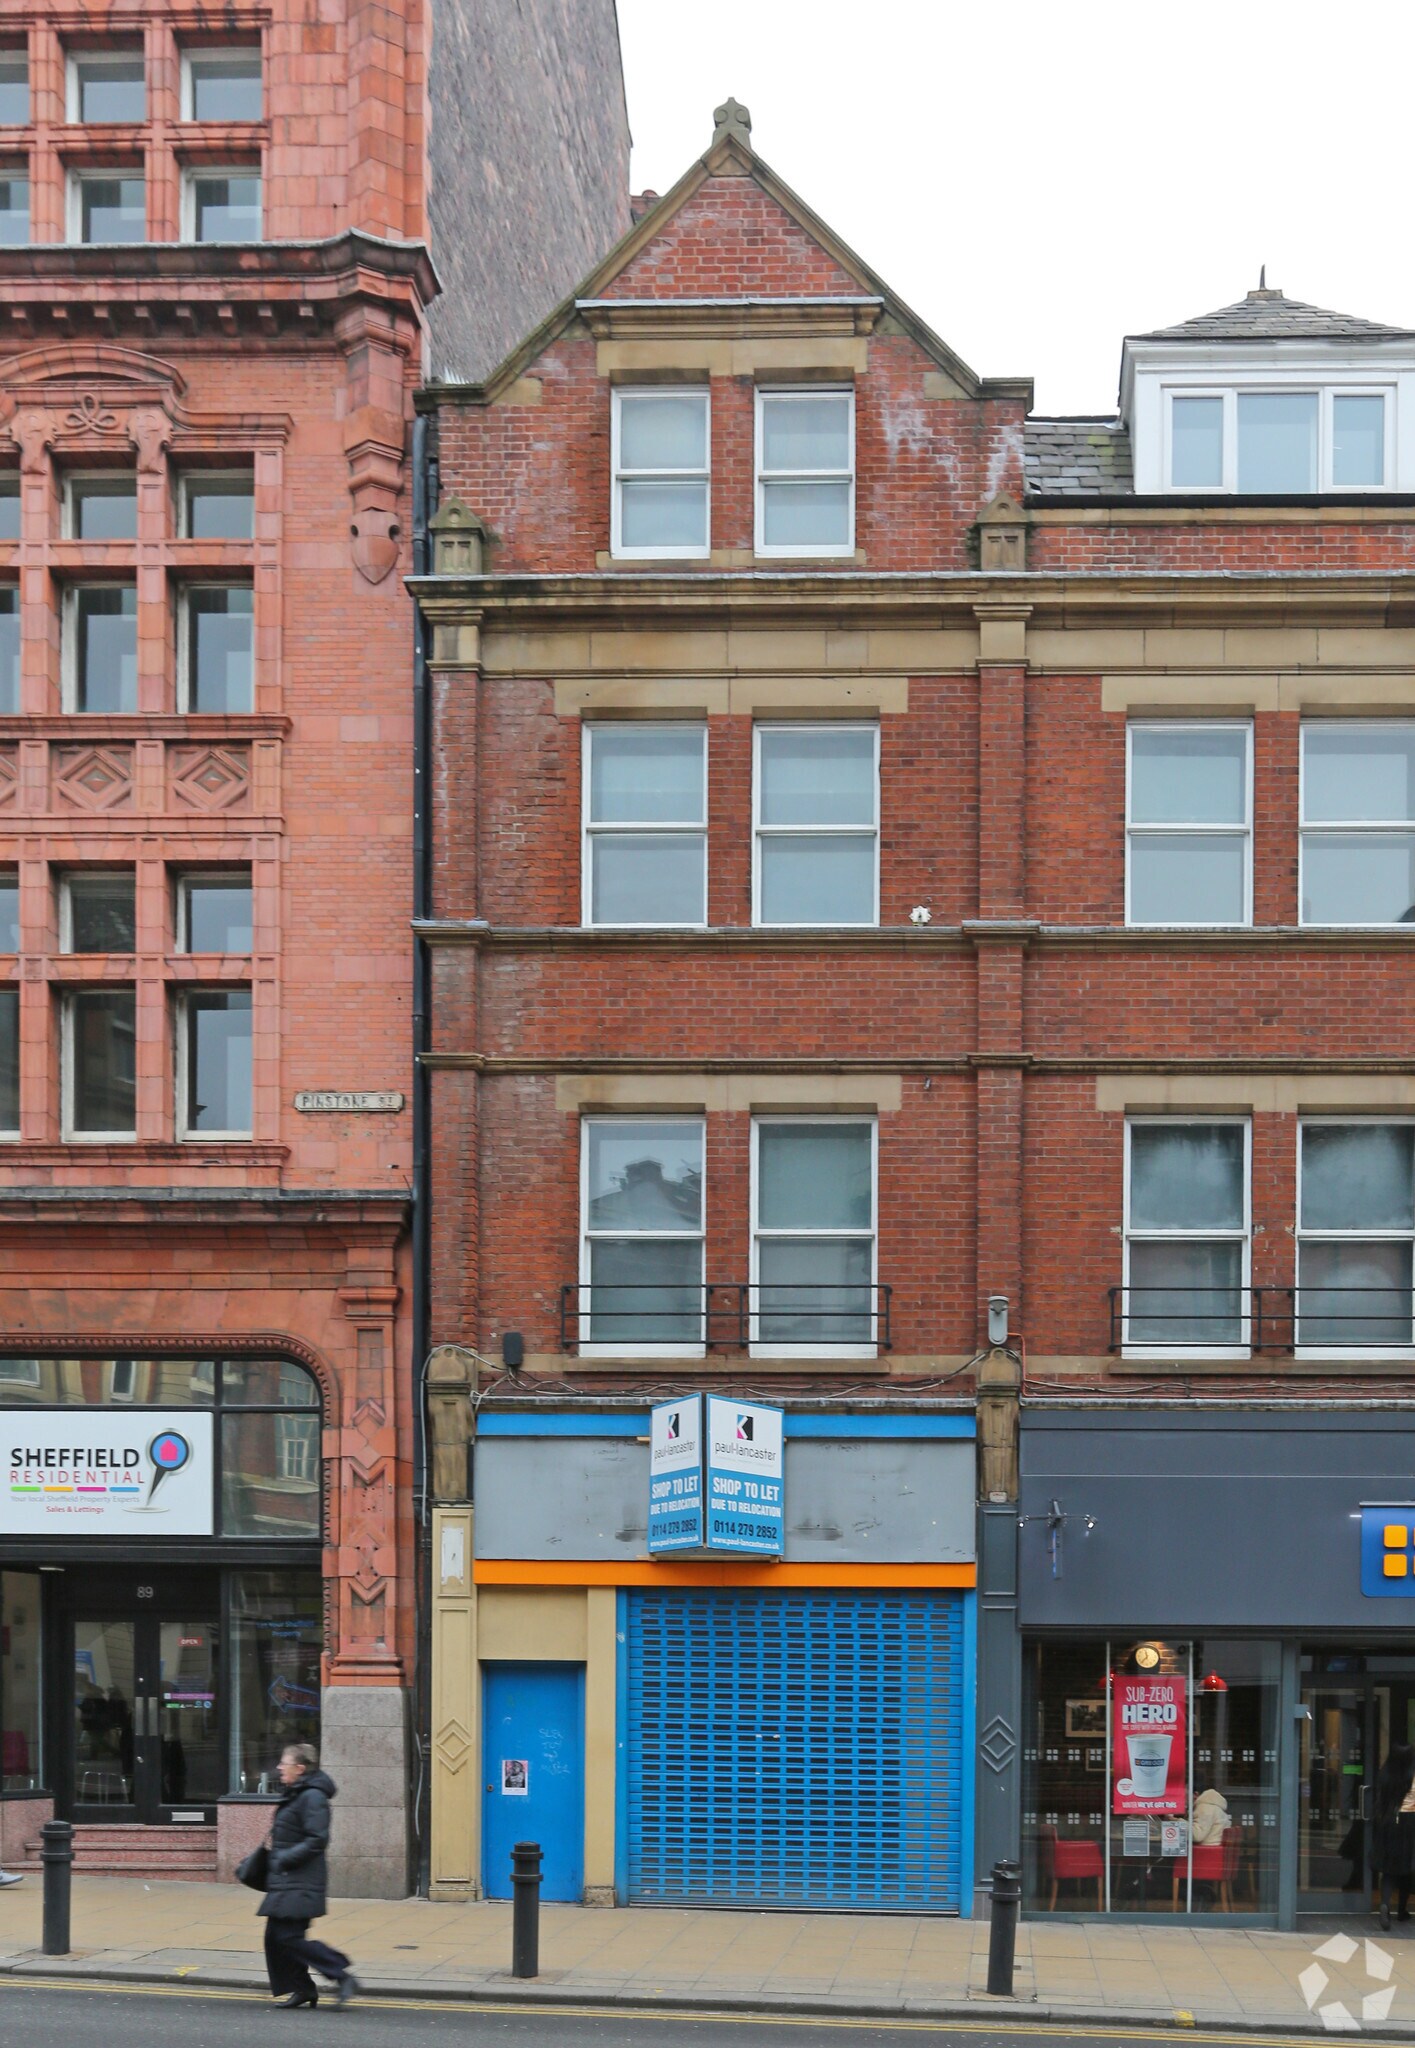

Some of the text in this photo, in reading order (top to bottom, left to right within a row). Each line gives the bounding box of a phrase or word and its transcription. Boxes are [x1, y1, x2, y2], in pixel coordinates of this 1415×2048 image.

[10, 1448, 140, 1467] SHEFFIELD
[10, 1471, 145, 1483] RESIDENTIAL
[652, 1475, 699, 1499] SHOP TO LET
[713, 1477, 779, 1501] SHOP TO LET
[80, 1496, 111, 1504] Property
[113, 1496, 140, 1504] Experts
[668, 1497, 700, 1513] RELOCATION
[711, 1498, 781, 1518] DUE TO RELOCATION
[74, 1506, 105, 1514] Lettings
[651, 1519, 697, 1537] 0114 279 2852
[714, 1520, 777, 1539] 0114 279 2852
[137, 1586, 154, 1598] 89
[1126, 1686, 1174, 1702] SUB-ZERO
[1122, 1703, 1177, 1724] HERO
